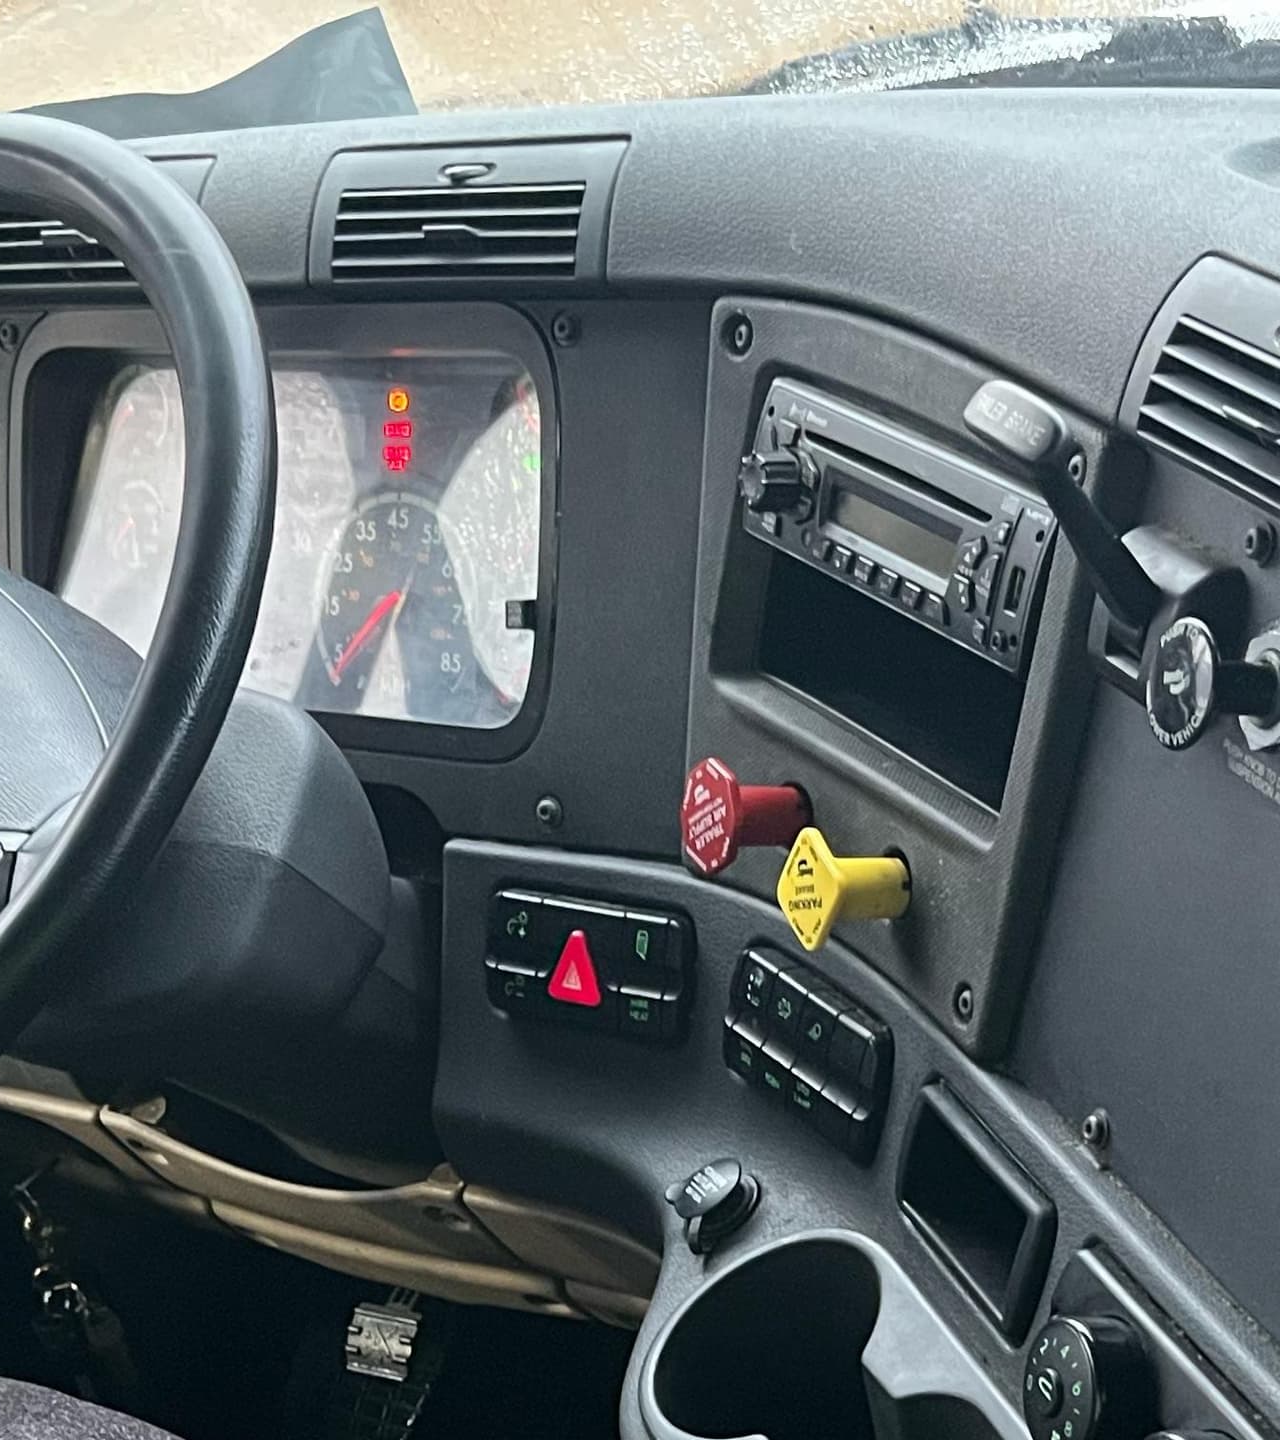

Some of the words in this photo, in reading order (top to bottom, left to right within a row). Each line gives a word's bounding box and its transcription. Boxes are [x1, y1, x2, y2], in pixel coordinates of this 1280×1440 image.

[388, 508, 409, 529] 45
[356, 520, 377, 541] 35
[421, 525, 442, 544] 55
[334, 553, 353, 573] 25
[323, 596, 341, 616] 15
[440, 653, 461, 672] 85
[787, 896, 823, 913] PARKING
[1039, 1337, 1049, 1355] 2
[1059, 1345, 1071, 1360] 4
[1071, 1380, 1083, 1396] 6
[1063, 1420, 1073, 1438] 8
